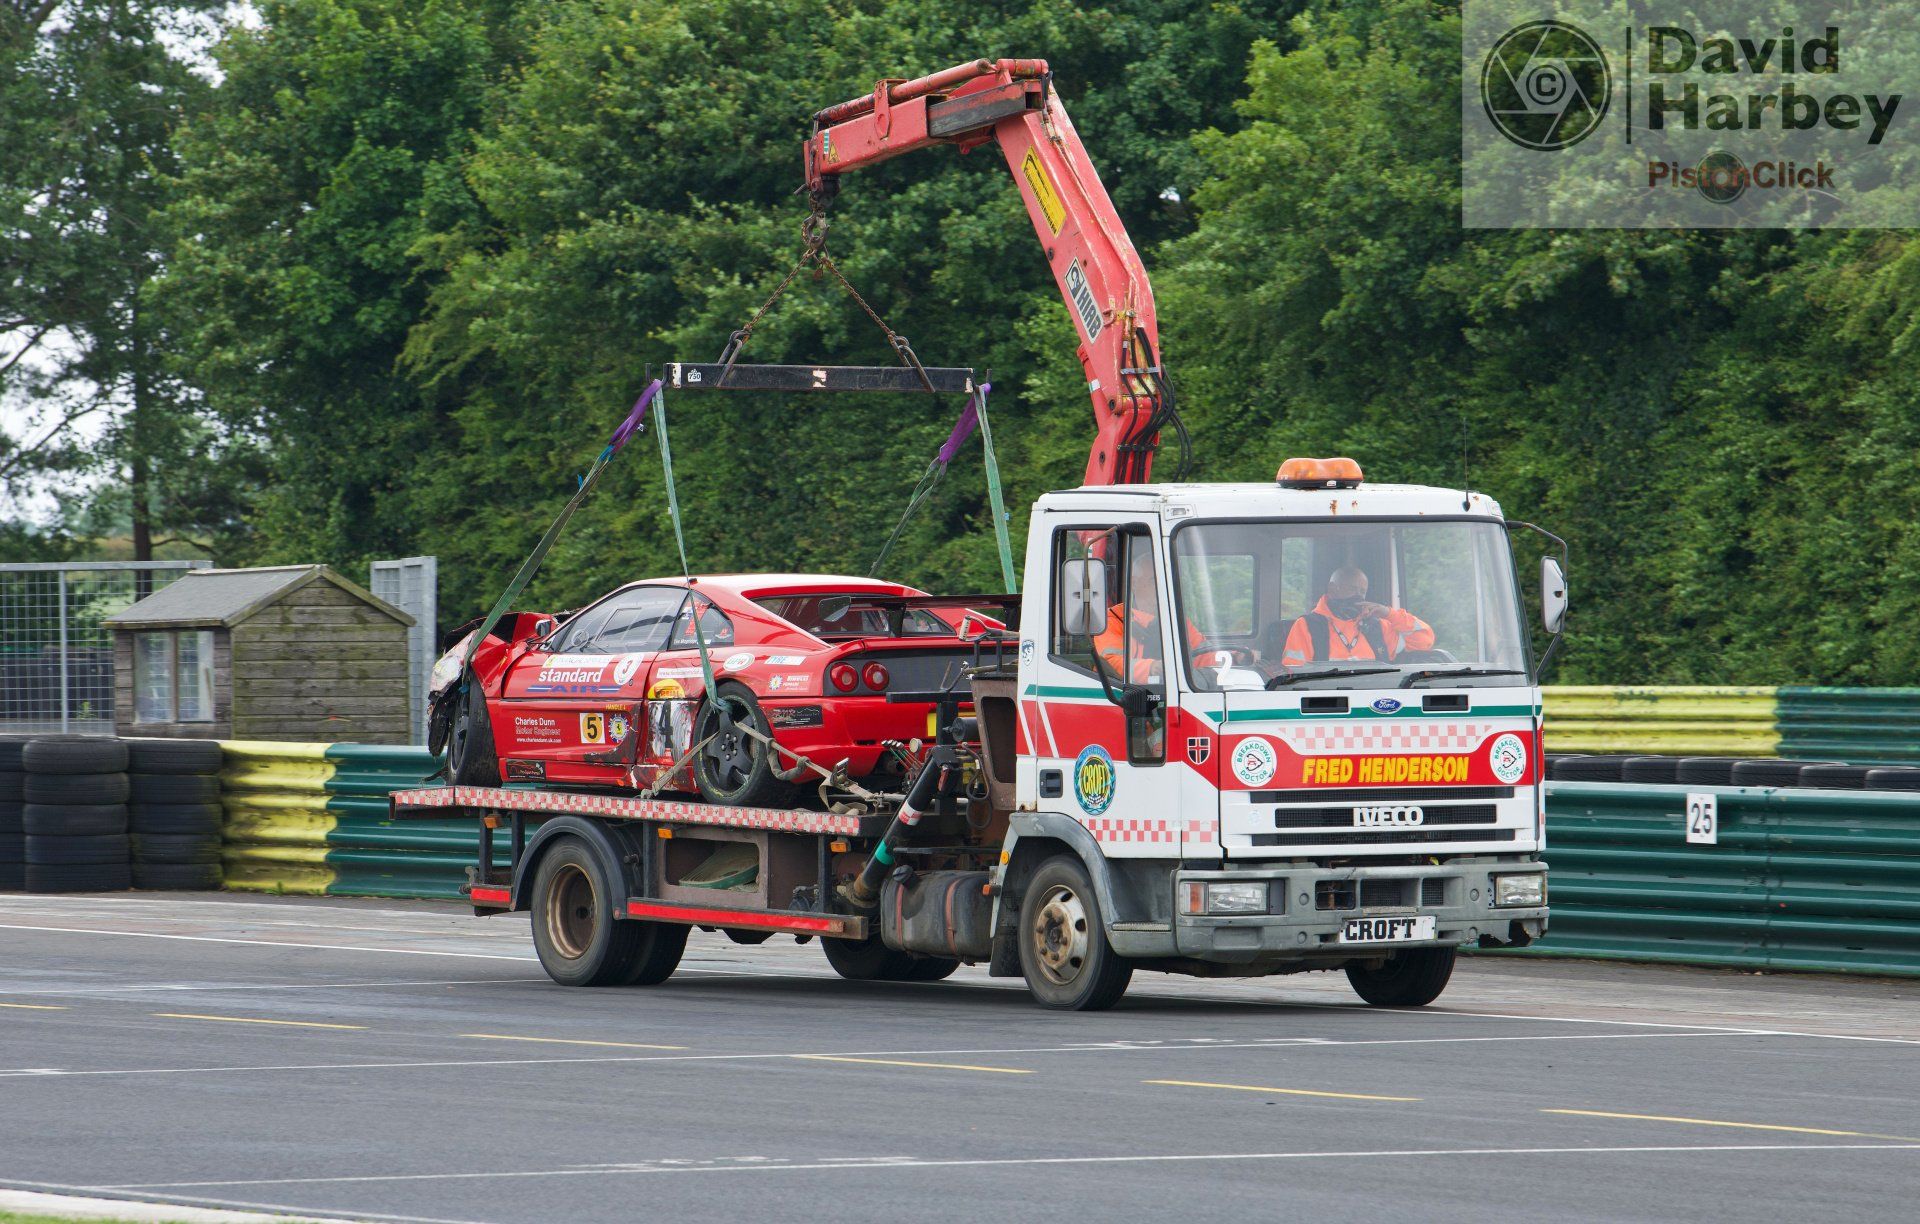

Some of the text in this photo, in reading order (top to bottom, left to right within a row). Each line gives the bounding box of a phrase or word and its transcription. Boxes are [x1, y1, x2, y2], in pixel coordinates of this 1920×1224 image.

[1076, 286, 1102, 340] HIAB
[539, 668, 604, 683] standard
[622, 659, 634, 675] 3
[1214, 650, 1234, 686] 2
[550, 685, 599, 693] AIR
[1377, 700, 1396, 710] Ford
[515, 716, 556, 726] Charles Dunn
[587, 716, 598, 740] 5
[658, 699, 674, 749] 4
[1237, 743, 1271, 763] BREAKDOWN
[1494, 740, 1522, 760] BREAKDOWN
[1083, 764, 1106, 794] CROFT
[1240, 769, 1268, 782] DOCTOR
[1302, 756, 1470, 784] FRED HENDERSON
[1497, 766, 1521, 778] DOCTOR
[1353, 806, 1424, 827] IVECO
[1691, 803, 1712, 834] 25
[1345, 919, 1416, 941] CROFT
